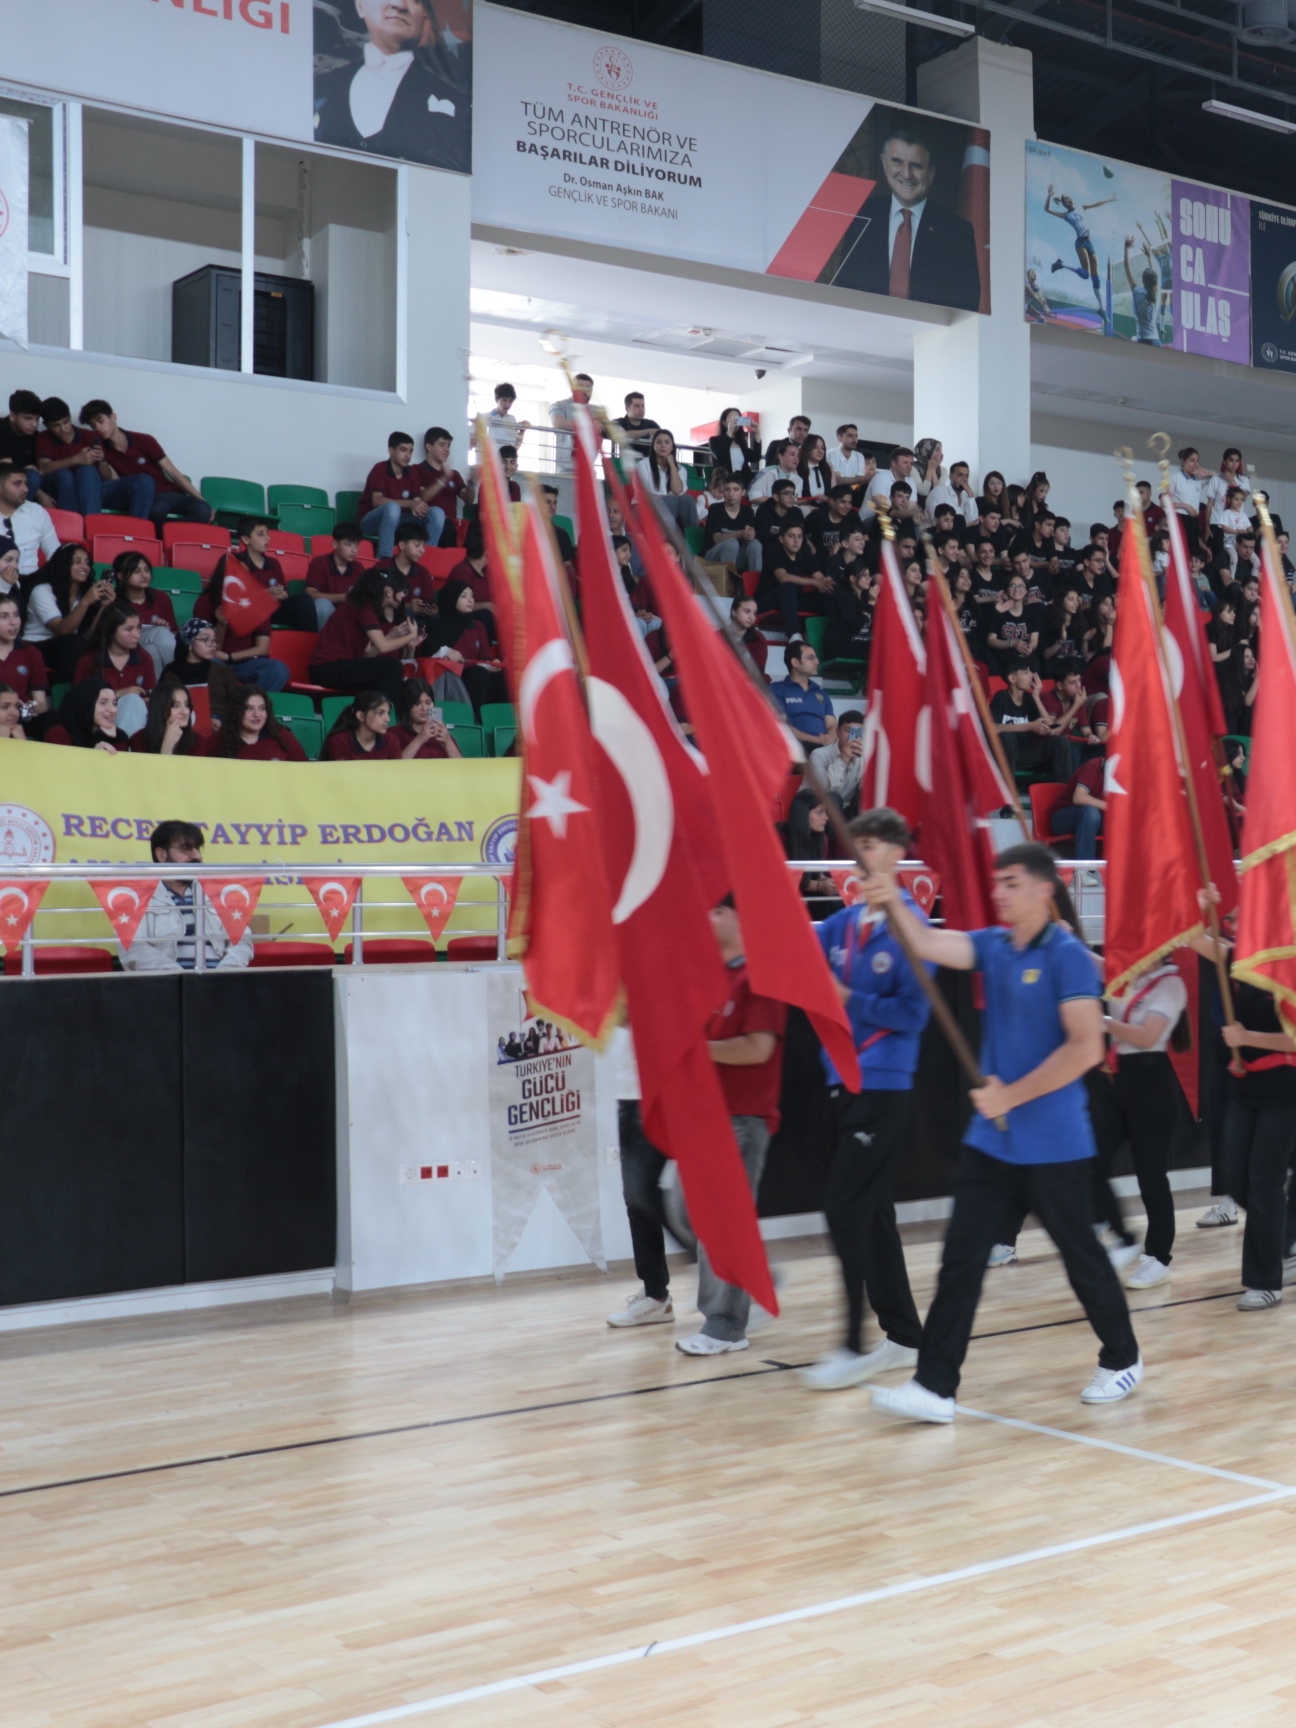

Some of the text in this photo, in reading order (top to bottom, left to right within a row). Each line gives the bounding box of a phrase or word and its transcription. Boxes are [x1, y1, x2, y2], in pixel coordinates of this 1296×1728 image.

[567, 82, 658, 110] T.C. GENÇLİK VE
[567, 93, 658, 121] SPOR BAKANLIĞI
[520, 100, 698, 152] TÜM ANTRENÖR VE
[527, 121, 693, 168] SPORCULARIMIZA
[516, 140, 702, 188] BAŞARILAR DİLİYORUM
[548, 185, 678, 221] GENÇLİK VE SPOR BAKANI
[563, 172, 665, 201] Dr. Osman Aşkın BAK
[1179, 198, 1232, 246] SONU
[1258, 210, 1280, 223] TÜRKİYE
[1180, 289, 1231, 342] ULAŞ
[61, 813, 164, 842] RECE
[318, 816, 474, 844] ERDOĞAN
[521, 1070, 566, 1100] GÜCÜ
[507, 1089, 581, 1126] GENÇLİĞİ
